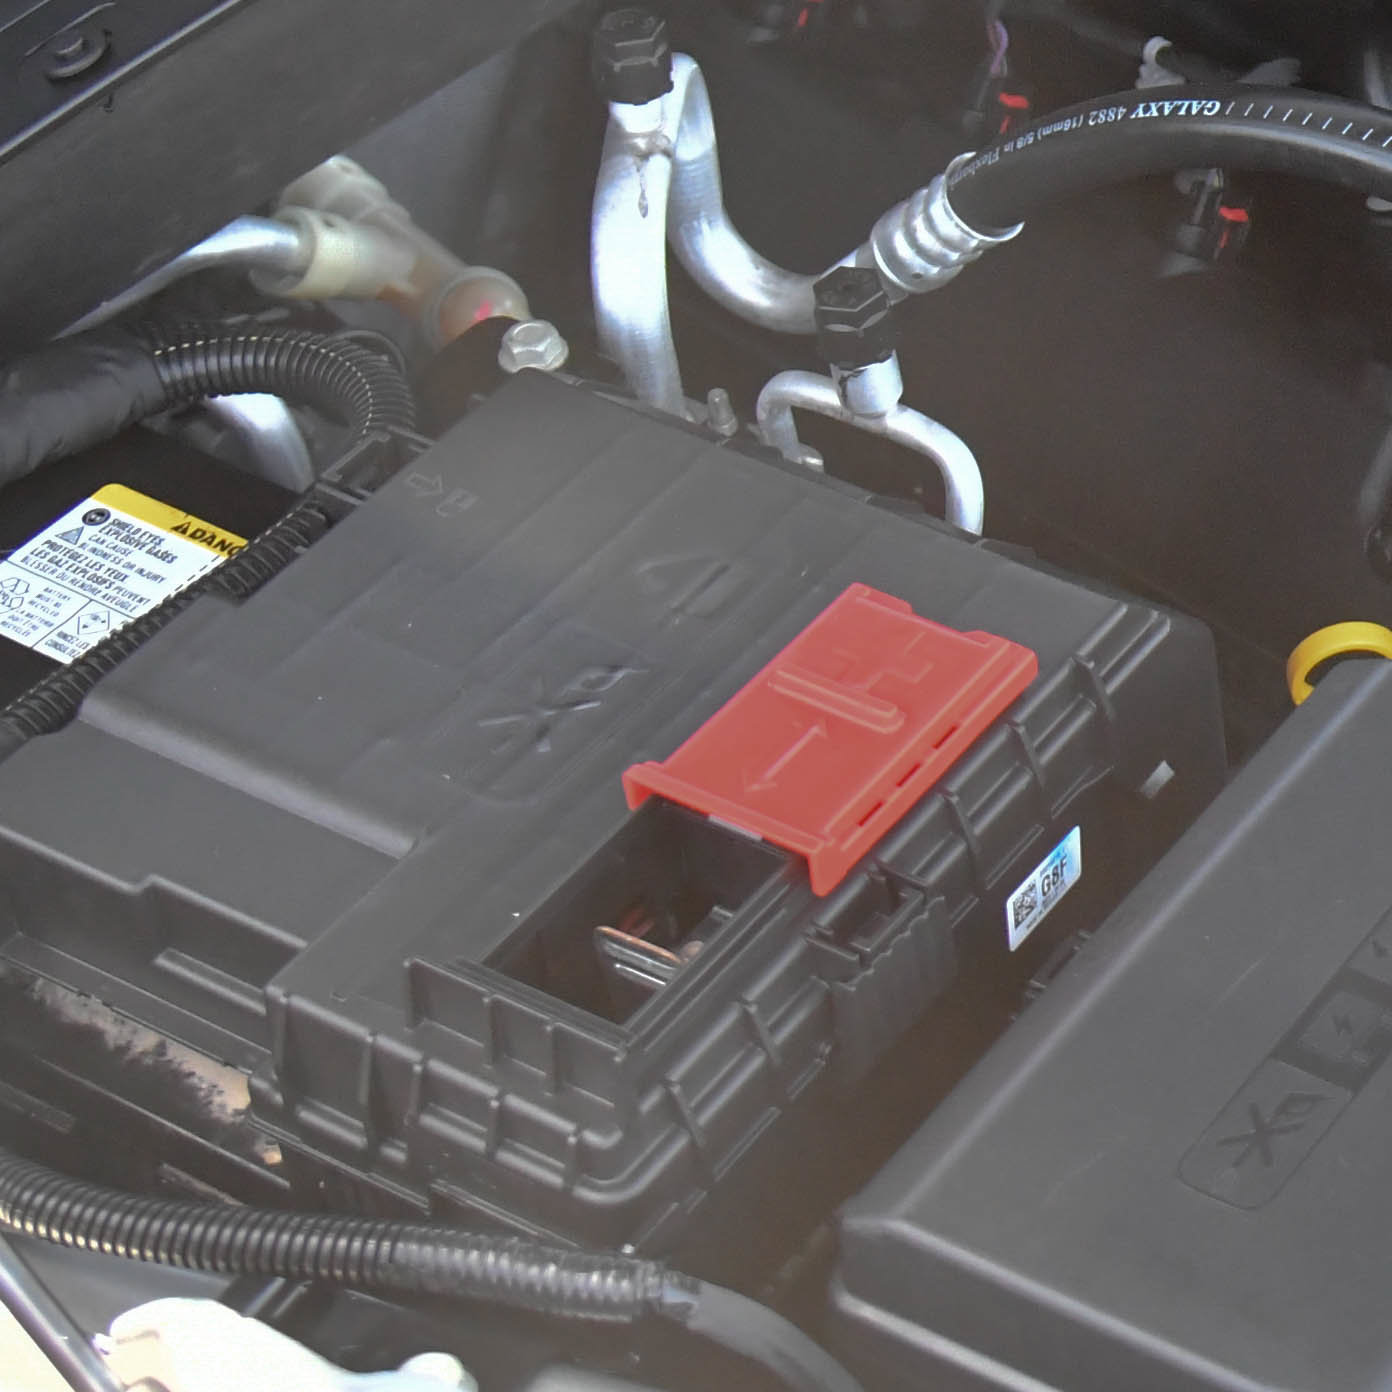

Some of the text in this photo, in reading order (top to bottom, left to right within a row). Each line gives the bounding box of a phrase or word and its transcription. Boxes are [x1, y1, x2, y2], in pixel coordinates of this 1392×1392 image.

[1089, 106, 1127, 126] 4882
[1130, 99, 1221, 119] GALAXY
[1037, 113, 1084, 140] (16mm)
[1016, 132, 1035, 149] 5/8
[107, 518, 142, 536] SHIELD
[88, 534, 134, 558] CAN CAUSE
[98, 524, 178, 564] EXPLOSIVE GASES
[29, 547, 151, 606] LES GAZ EXPLOSIFS PEUVENT
[84, 559, 106, 572] LES
[1041, 855, 1067, 897] G8F
